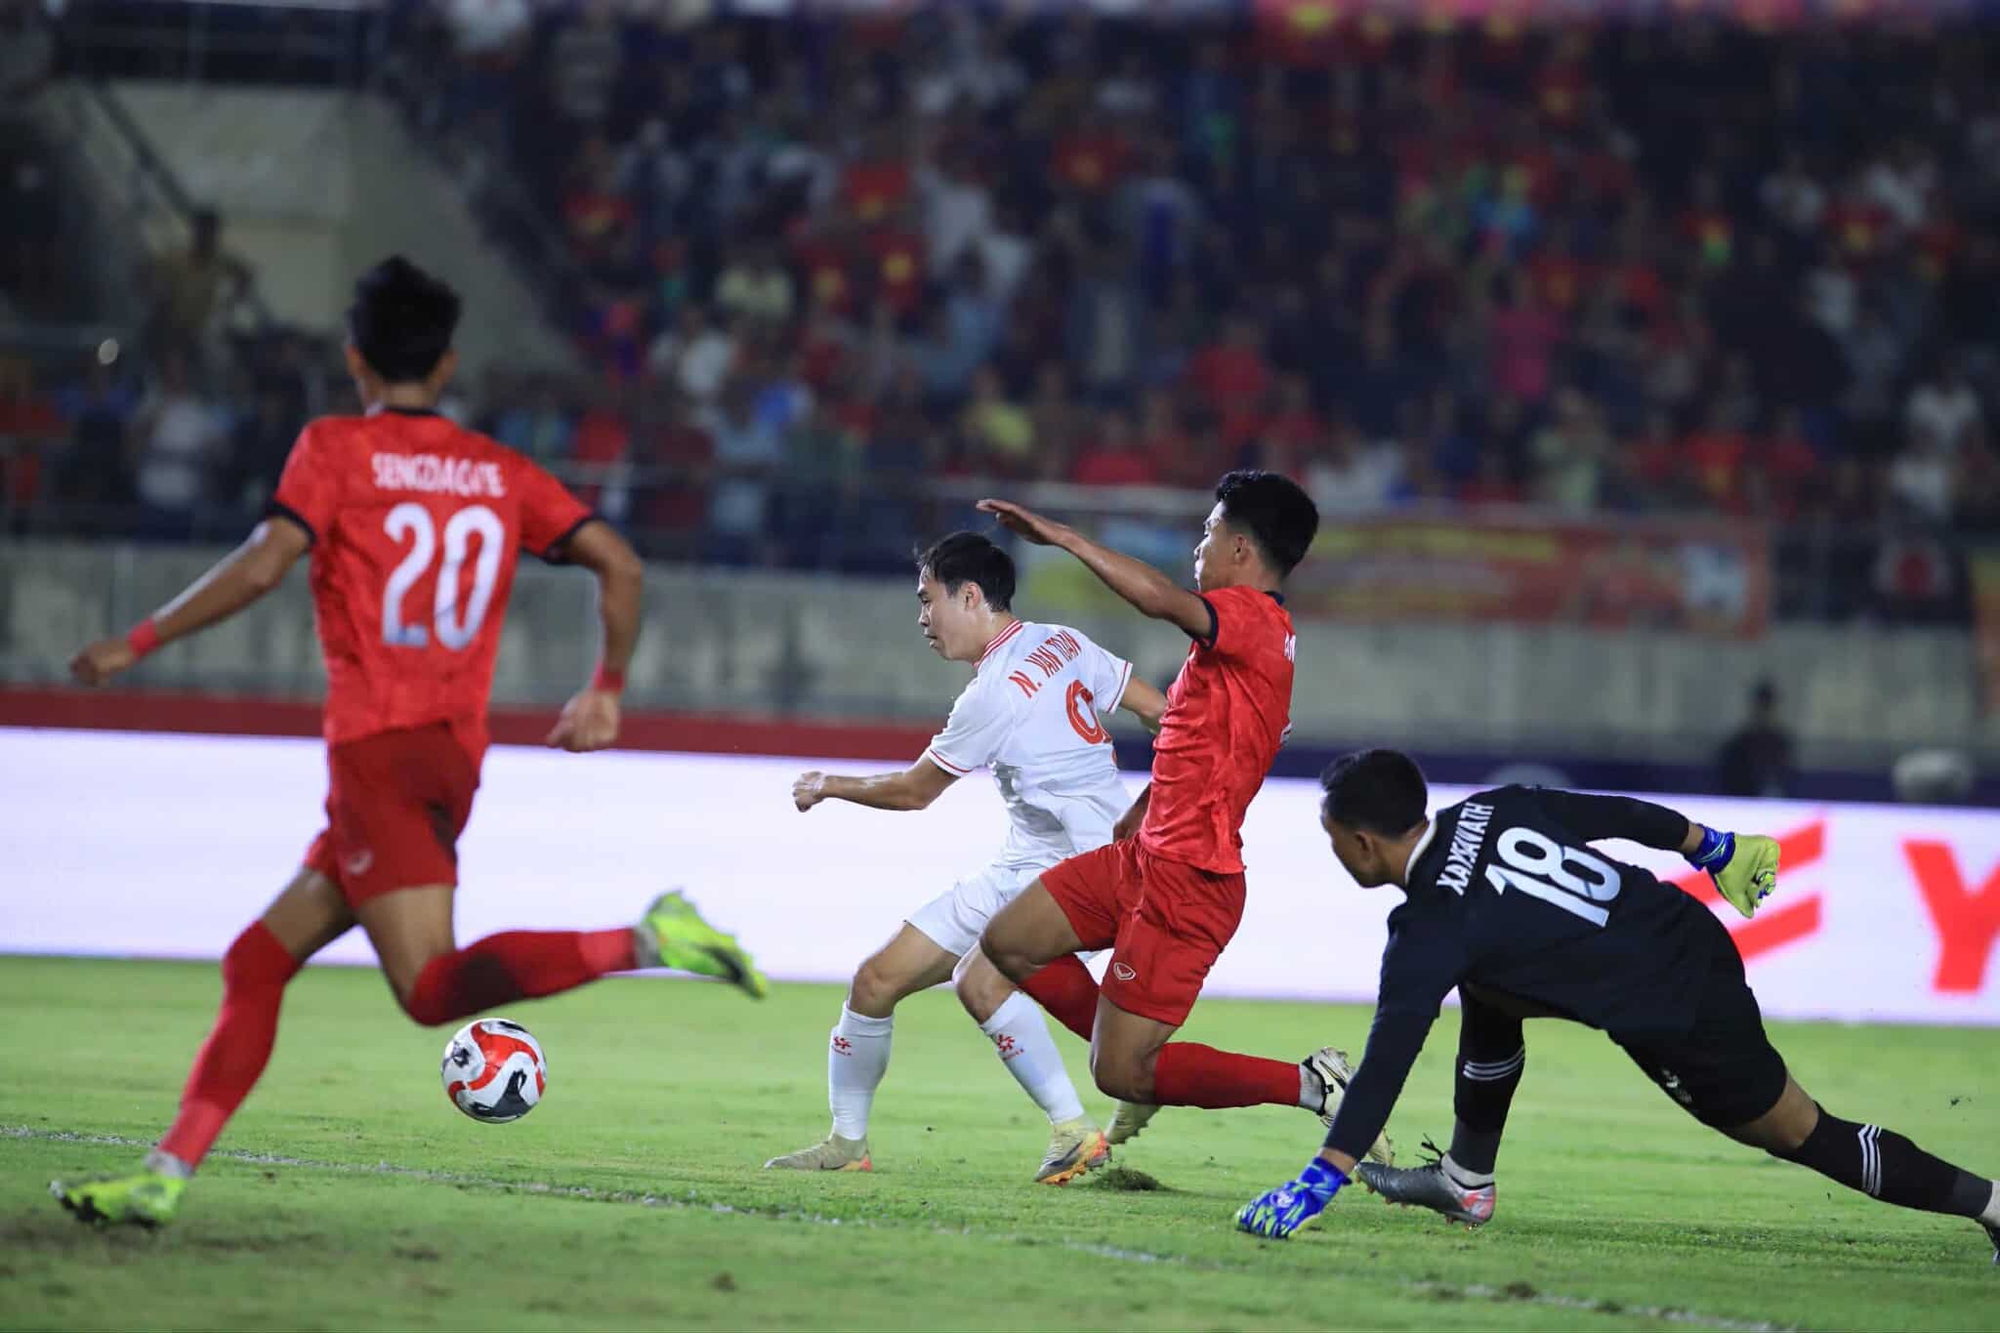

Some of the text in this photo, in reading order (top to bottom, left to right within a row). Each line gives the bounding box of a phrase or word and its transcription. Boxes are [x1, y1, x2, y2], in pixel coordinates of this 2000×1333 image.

[381, 501, 505, 650] 20
[1008, 669, 1043, 699] N.
[1484, 826, 1622, 929] 18
